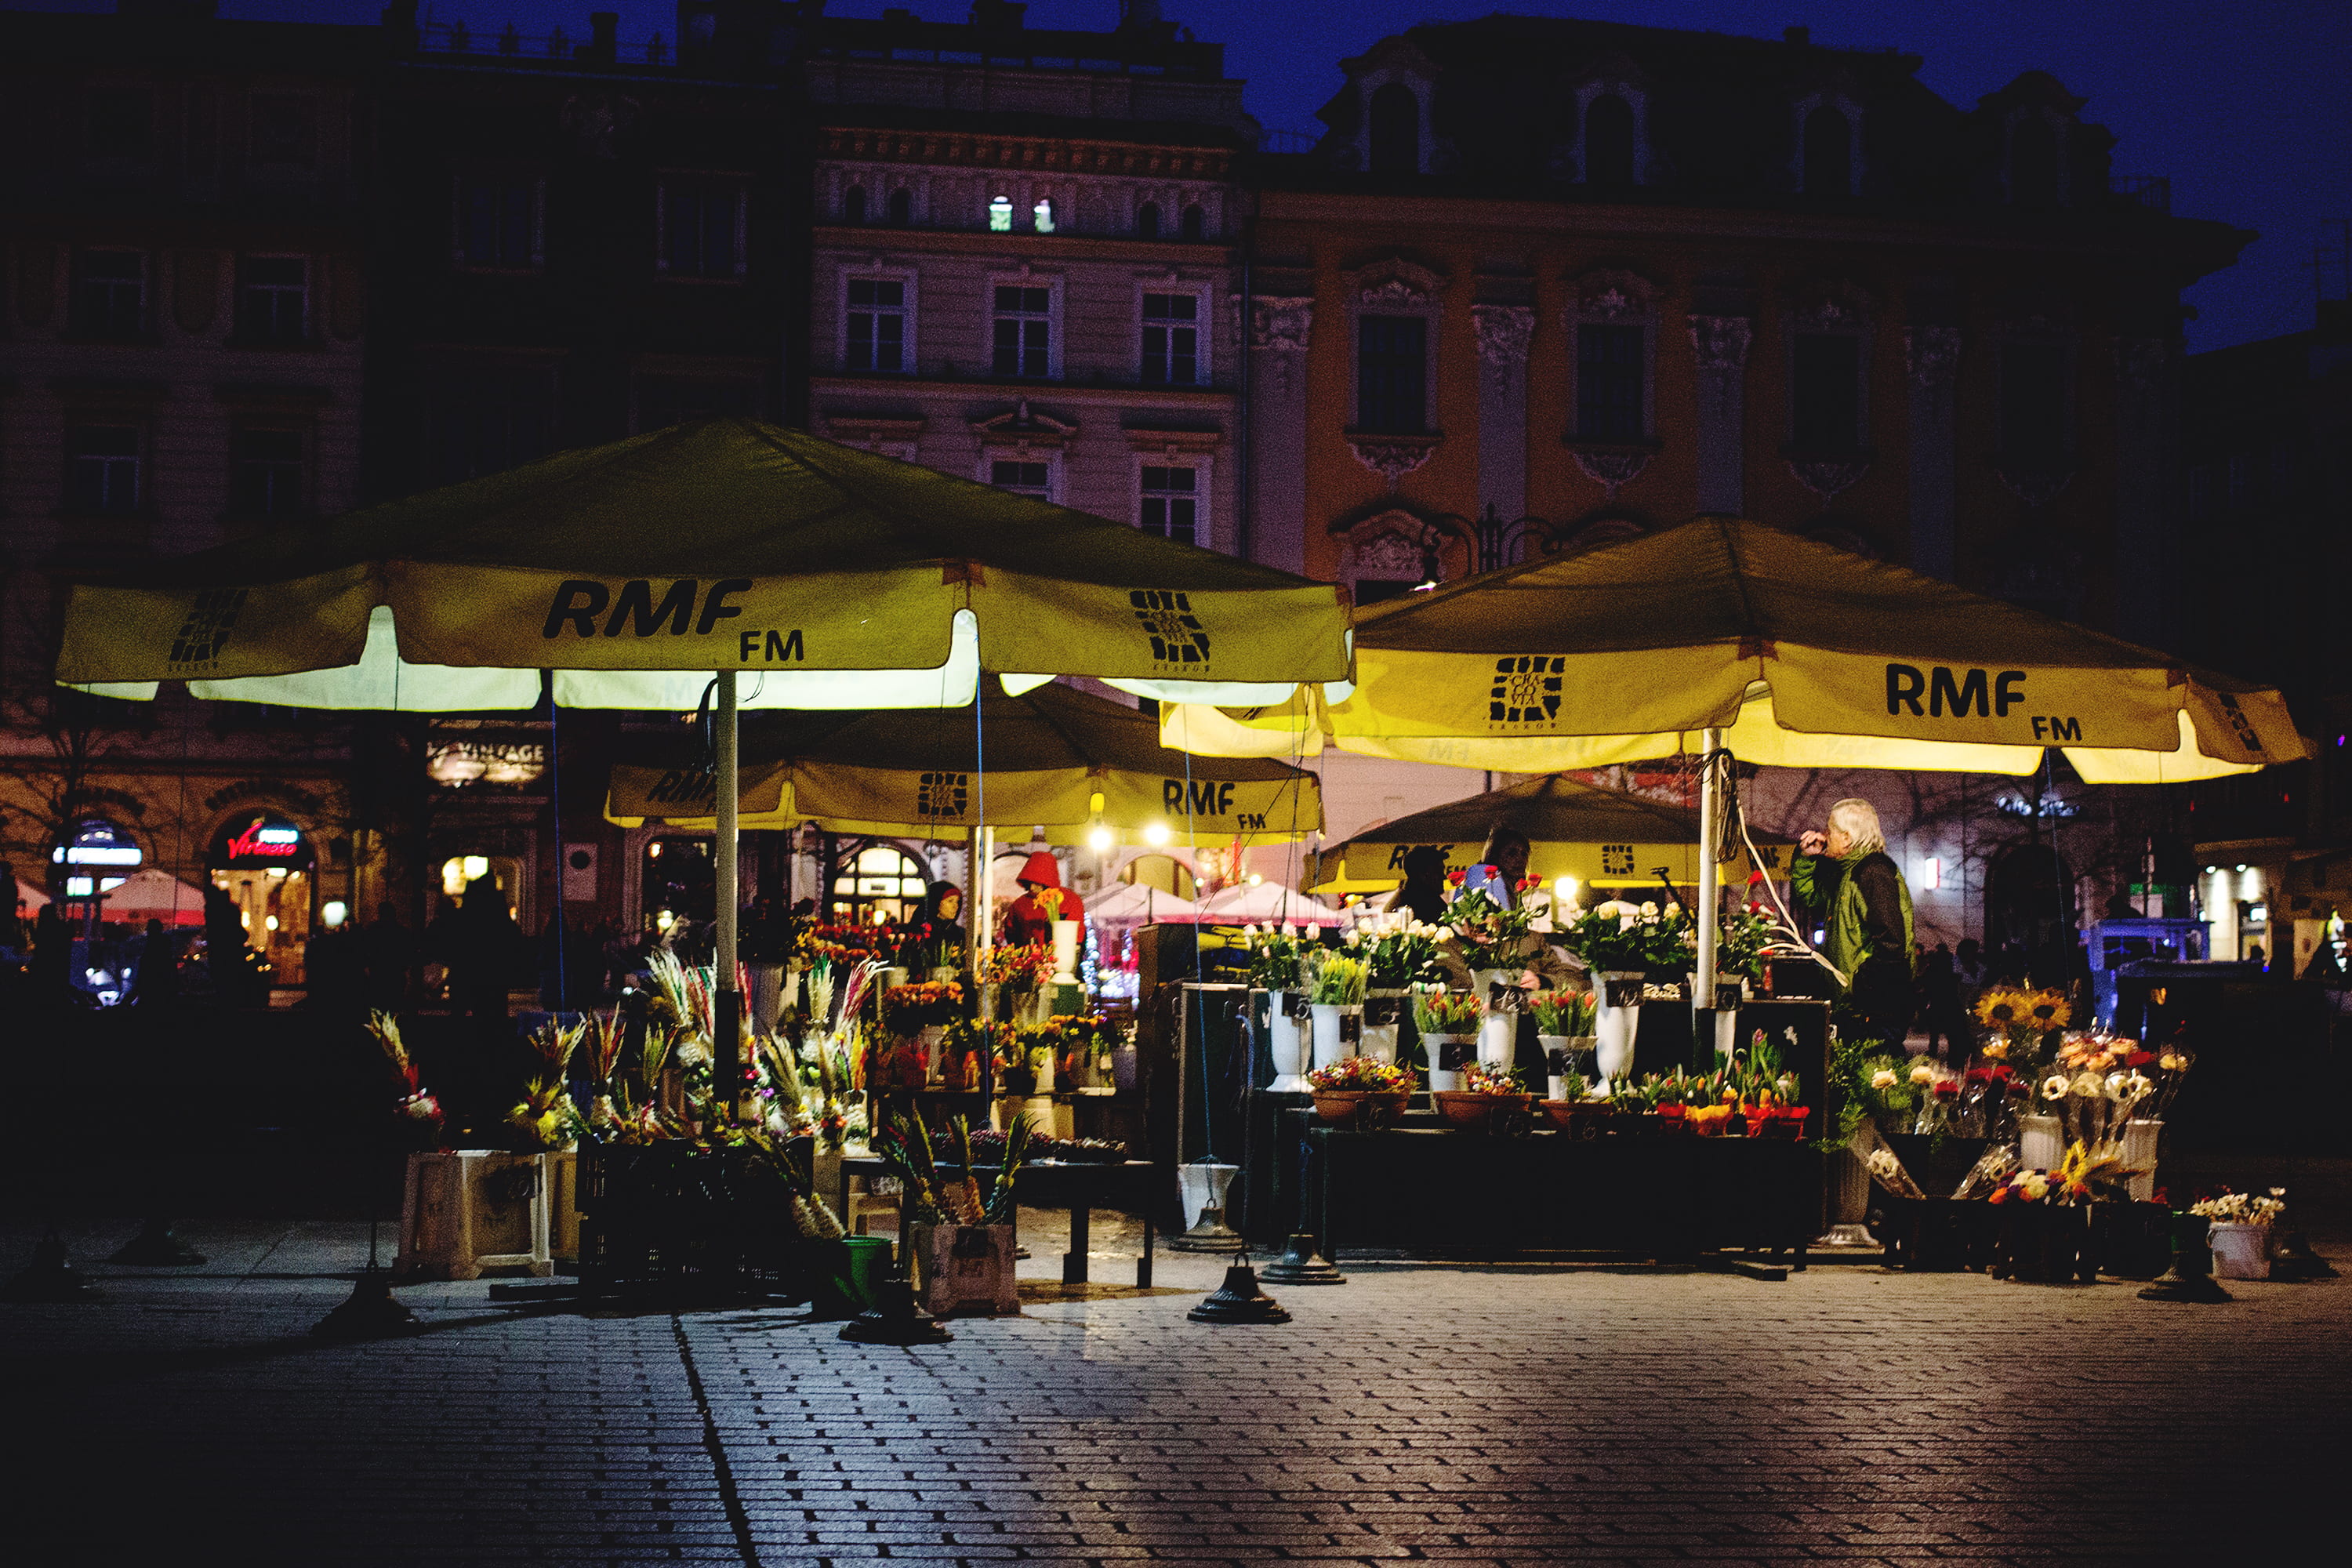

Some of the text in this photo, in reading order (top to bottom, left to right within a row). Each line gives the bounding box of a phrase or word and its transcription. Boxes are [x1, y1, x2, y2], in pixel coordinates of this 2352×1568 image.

[543, 579, 804, 662] RMF FM
[1886, 663, 2082, 740] RMF FM
[1164, 779, 1266, 829] RMF FM
[227, 822, 297, 859] Virtuoso
